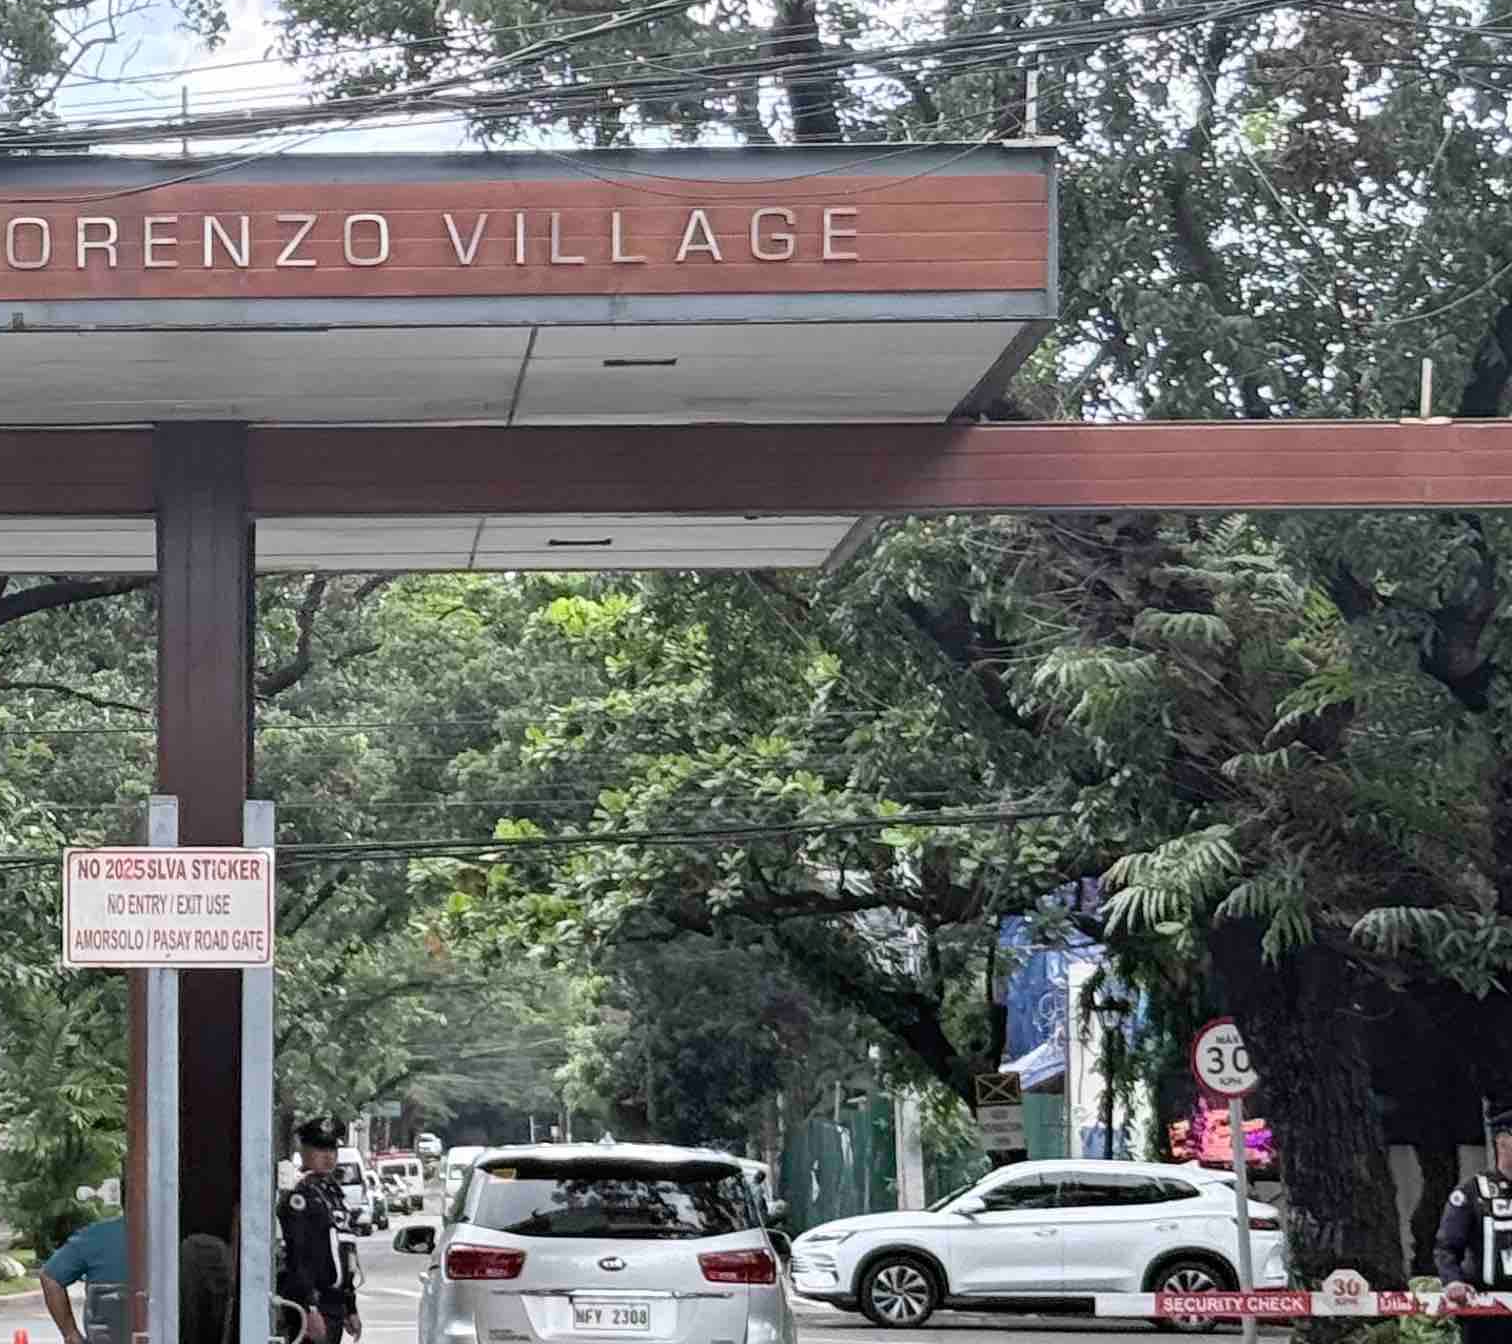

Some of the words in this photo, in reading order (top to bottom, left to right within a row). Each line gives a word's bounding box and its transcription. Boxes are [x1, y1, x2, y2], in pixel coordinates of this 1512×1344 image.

[443, 206, 861, 265] VILLAGE
[78, 859, 100, 880] NO
[105, 859, 147, 880] 2025
[147, 858, 187, 880] SLVA
[192, 858, 261, 880] STICKER
[107, 894, 125, 915] NO
[128, 894, 168, 915] ENTRY
[177, 894, 202, 915] EXIT
[206, 894, 231, 914] USE
[75, 929, 143, 950] AMORSOLO
[153, 929, 193, 950] PASAY
[195, 929, 227, 950] ROAD
[232, 929, 264, 951] GATE
[1207, 1046, 1252, 1074] 30
[1333, 1279, 1360, 1297] 30
[1163, 1296, 1243, 1313] SECURITY
[1247, 1295, 1305, 1312] CHECK
